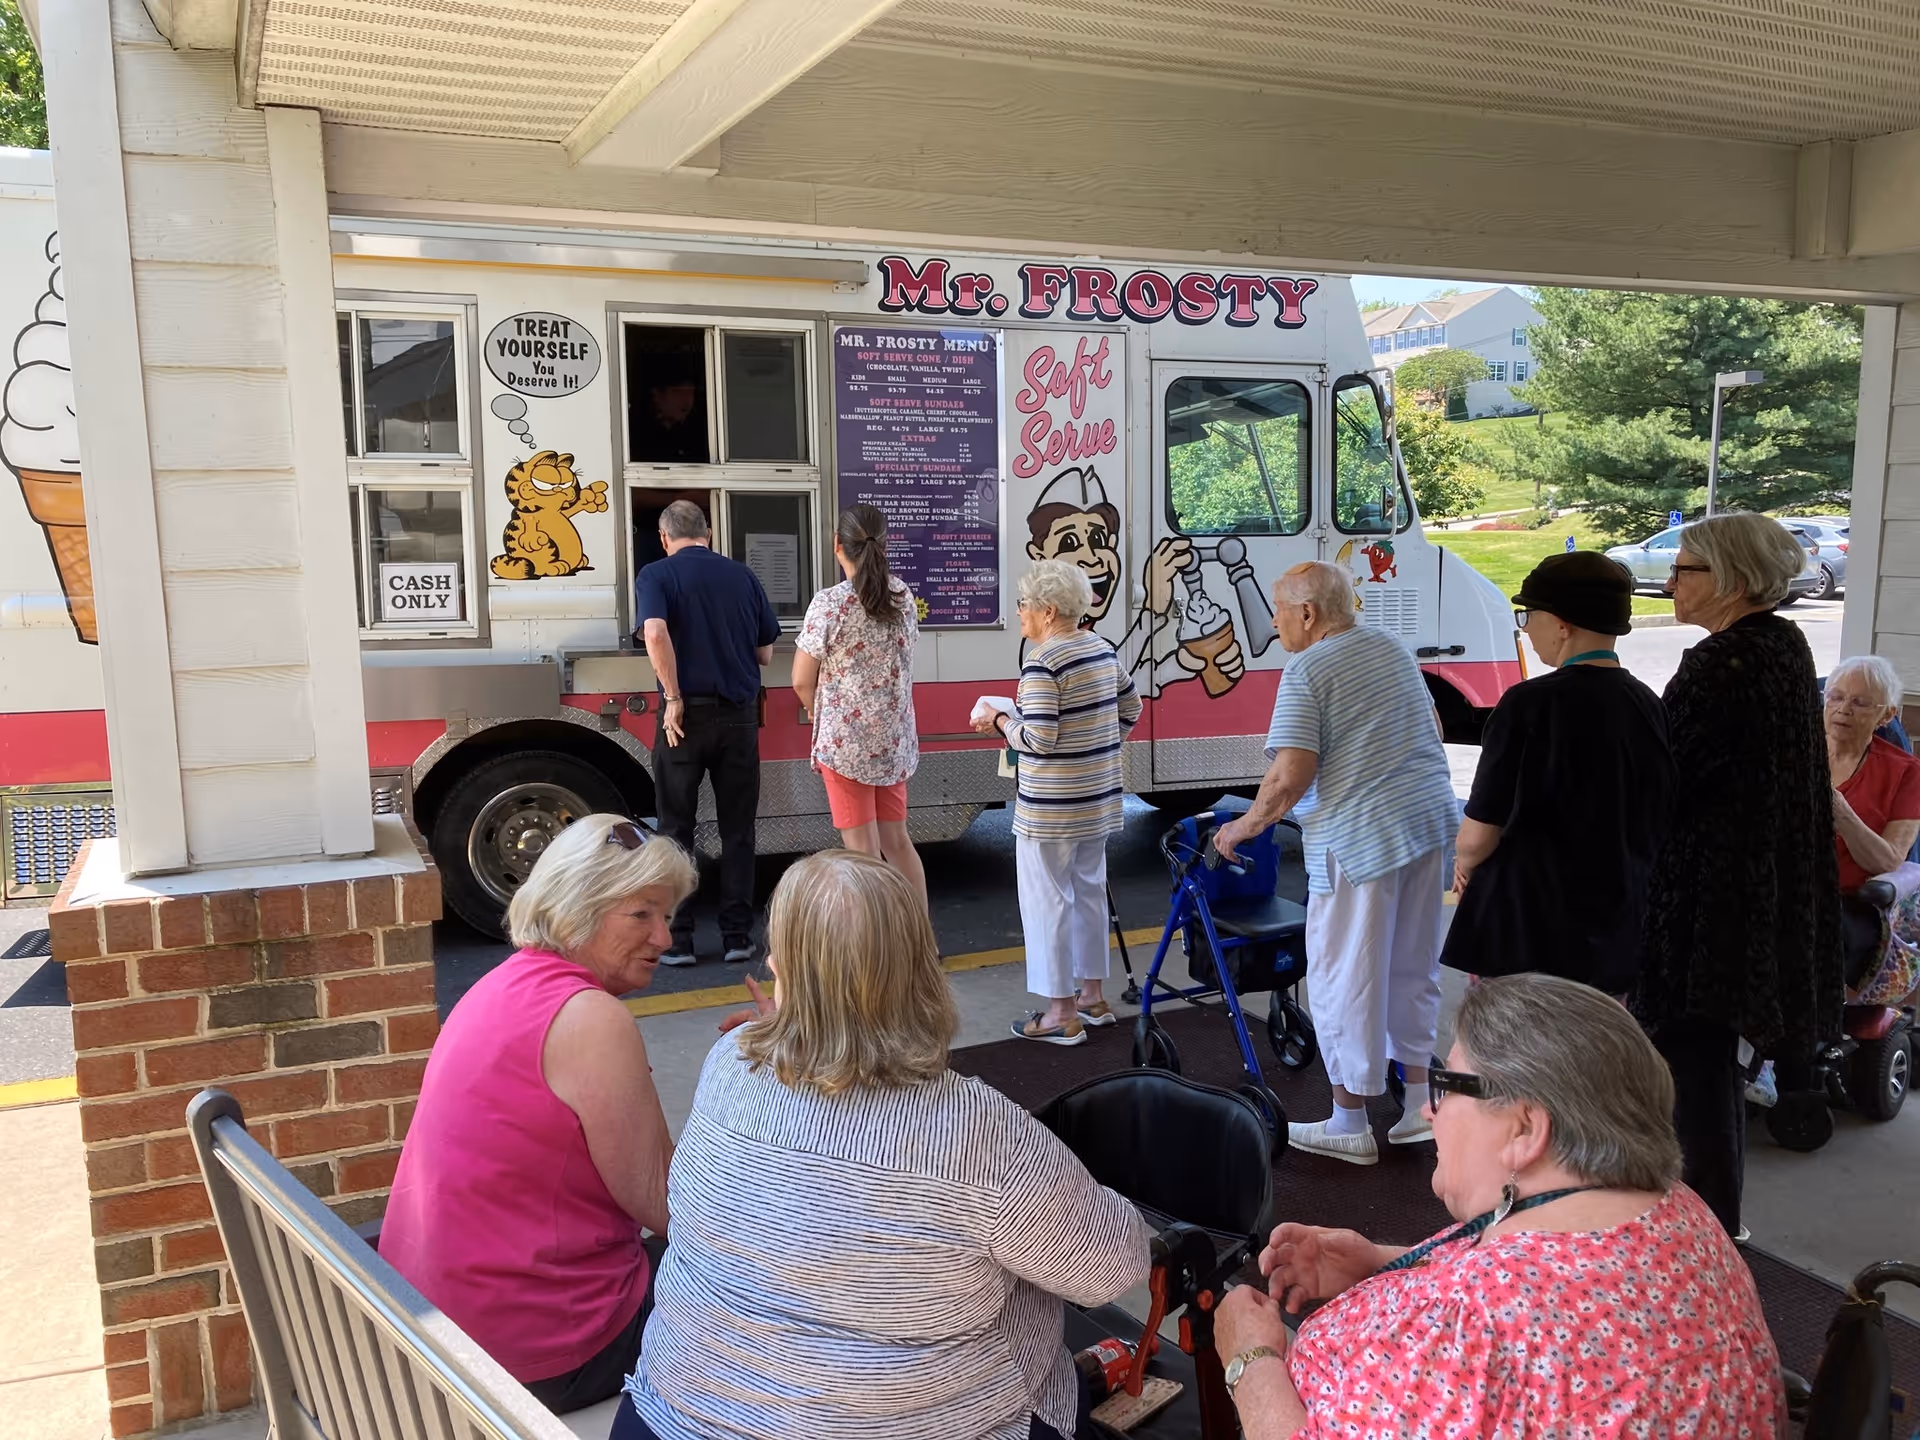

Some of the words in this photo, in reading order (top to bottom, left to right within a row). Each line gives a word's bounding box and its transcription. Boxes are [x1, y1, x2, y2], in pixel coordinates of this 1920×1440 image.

[878, 255, 1008, 317] Mr.
[1018, 263, 1318, 328] FROSTY
[514, 318, 570, 338] TREAT
[497, 338, 588, 360] YOURSELF
[840, 334, 870, 347] MR.
[876, 336, 938, 350] FROSTY
[944, 339, 989, 352] MENU
[857, 352, 880, 360] SOFT
[884, 352, 913, 362] SERVE
[917, 354, 941, 364] CONE
[952, 356, 974, 365] DISH
[533, 360, 554, 375] You
[866, 363, 909, 372] (CHOCOLATE,
[508, 371, 557, 387] Deserve
[564, 374, 578, 388] It!
[1015, 336, 1111, 419] Soft
[870, 398, 891, 406] SOFT
[894, 399, 922, 407] SERVE
[925, 400, 964, 409] SUNDAES
[1013, 411, 1117, 478] Serve
[389, 575, 451, 590] CASH
[391, 594, 450, 609] ONLY
